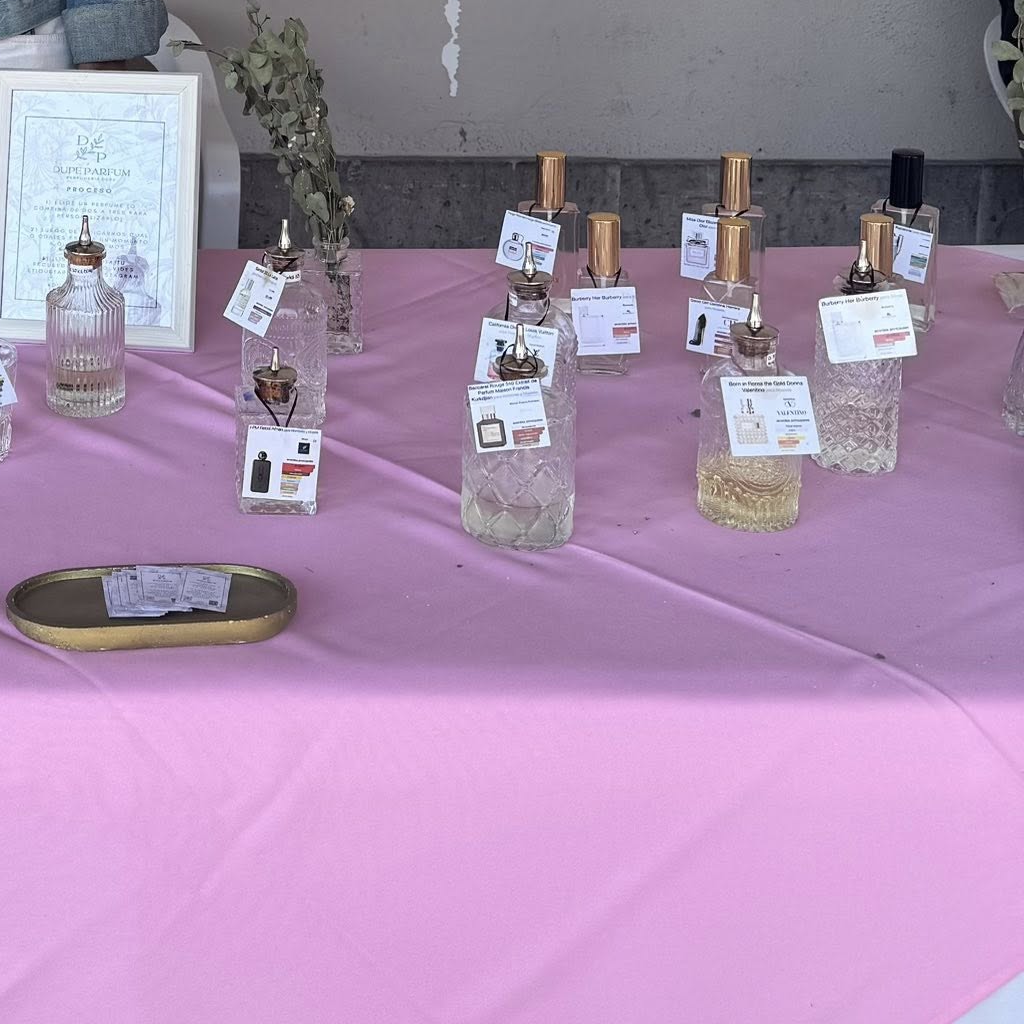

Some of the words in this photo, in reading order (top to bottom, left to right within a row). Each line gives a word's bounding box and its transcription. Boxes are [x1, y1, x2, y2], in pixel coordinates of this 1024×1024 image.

[77, 135, 89, 146] D
[97, 152, 107, 163] P
[53, 166, 82, 175] DUPE
[84, 167, 131, 177] PARFUM
[66, 186, 112, 194] PROCESO
[821, 299, 844, 307] Burberry
[855, 295, 880, 303] Burberry
[488, 321, 509, 329] California
